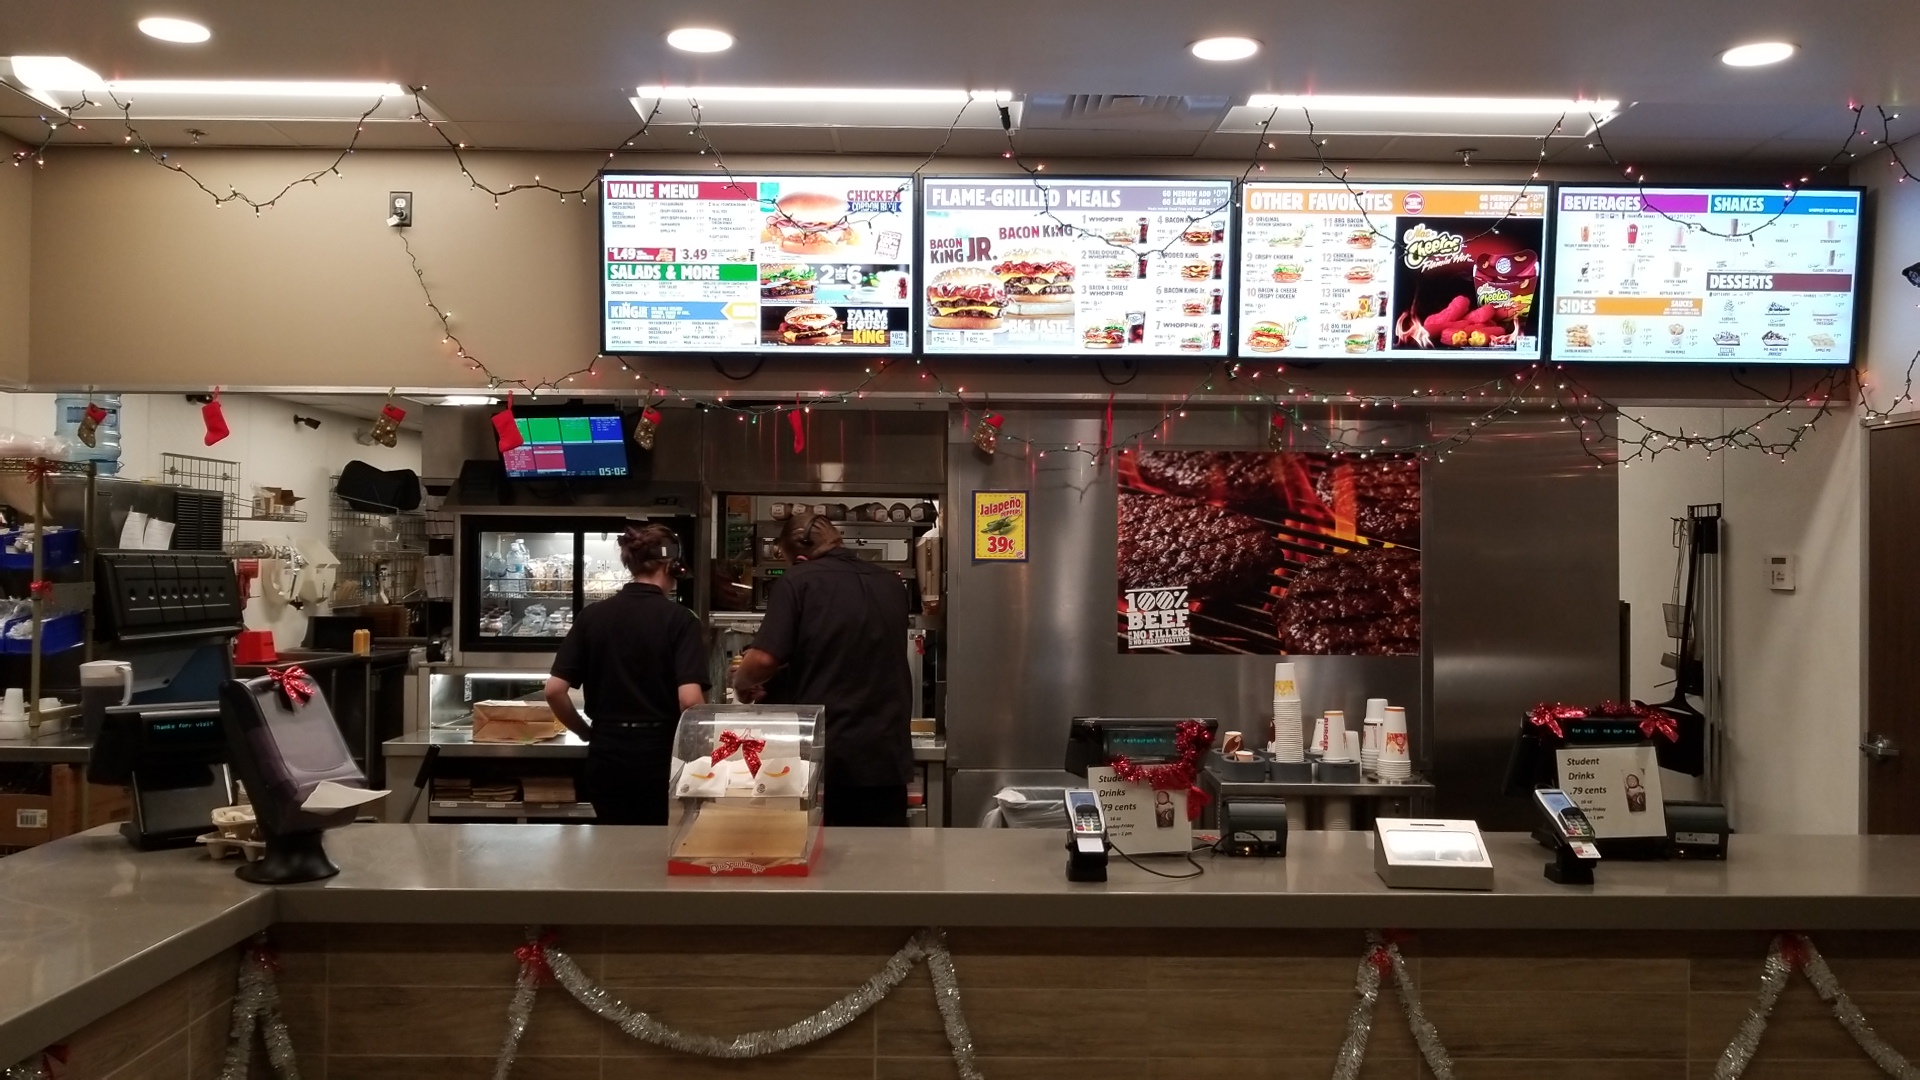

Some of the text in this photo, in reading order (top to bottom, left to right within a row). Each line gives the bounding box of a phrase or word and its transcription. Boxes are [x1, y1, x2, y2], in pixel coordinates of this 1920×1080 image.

[610, 183, 699, 199] VALUE MENU
[847, 189, 901, 201] CHICKEN
[1066, 189, 1121, 208] MEALS
[1162, 198, 1171, 206] GO
[1172, 197, 1197, 206] LARGE
[1250, 192, 1303, 210] OTHER
[1308, 192, 1393, 211] FAVORITES
[1489, 194, 1514, 202] MEDIUM
[1564, 195, 1641, 211] BEVERAGES
[1714, 197, 1764, 212] SHAKES
[1157, 215, 1163, 224] 4
[1248, 217, 1254, 226] 8
[999, 226, 1040, 240] BACON
[930, 238, 963, 250] BACON
[967, 237, 998, 262] JR.
[1081, 250, 1087, 260] 2
[1247, 252, 1253, 262] 9
[610, 264, 720, 280] SALADS & MORE
[820, 265, 835, 284] 2
[1710, 275, 1773, 290] DESSERTS
[1081, 285, 1087, 295] 3
[1156, 286, 1162, 295] 6
[1247, 287, 1256, 297] 10
[1559, 300, 1596, 314] SIDES
[847, 309, 888, 321] FARM
[847, 320, 888, 330] HOUSE
[1156, 320, 1161, 330] 7
[598, 467, 627, 476] 05:02
[980, 496, 1021, 515] Jalapeño
[987, 536, 1014, 553] 39¢
[1124, 590, 1189, 612] 100%
[1127, 609, 1190, 630] BEEF
[1133, 627, 1190, 640] NO FILLERS
[1143, 636, 1190, 645] PRESERVATIVES
[1566, 758, 1600, 766] Student
[1098, 775, 1126, 783] Stude
[1568, 772, 1595, 780] Drinks
[1099, 788, 1126, 797] Drinks
[1570, 786, 1607, 795] .79 cents
